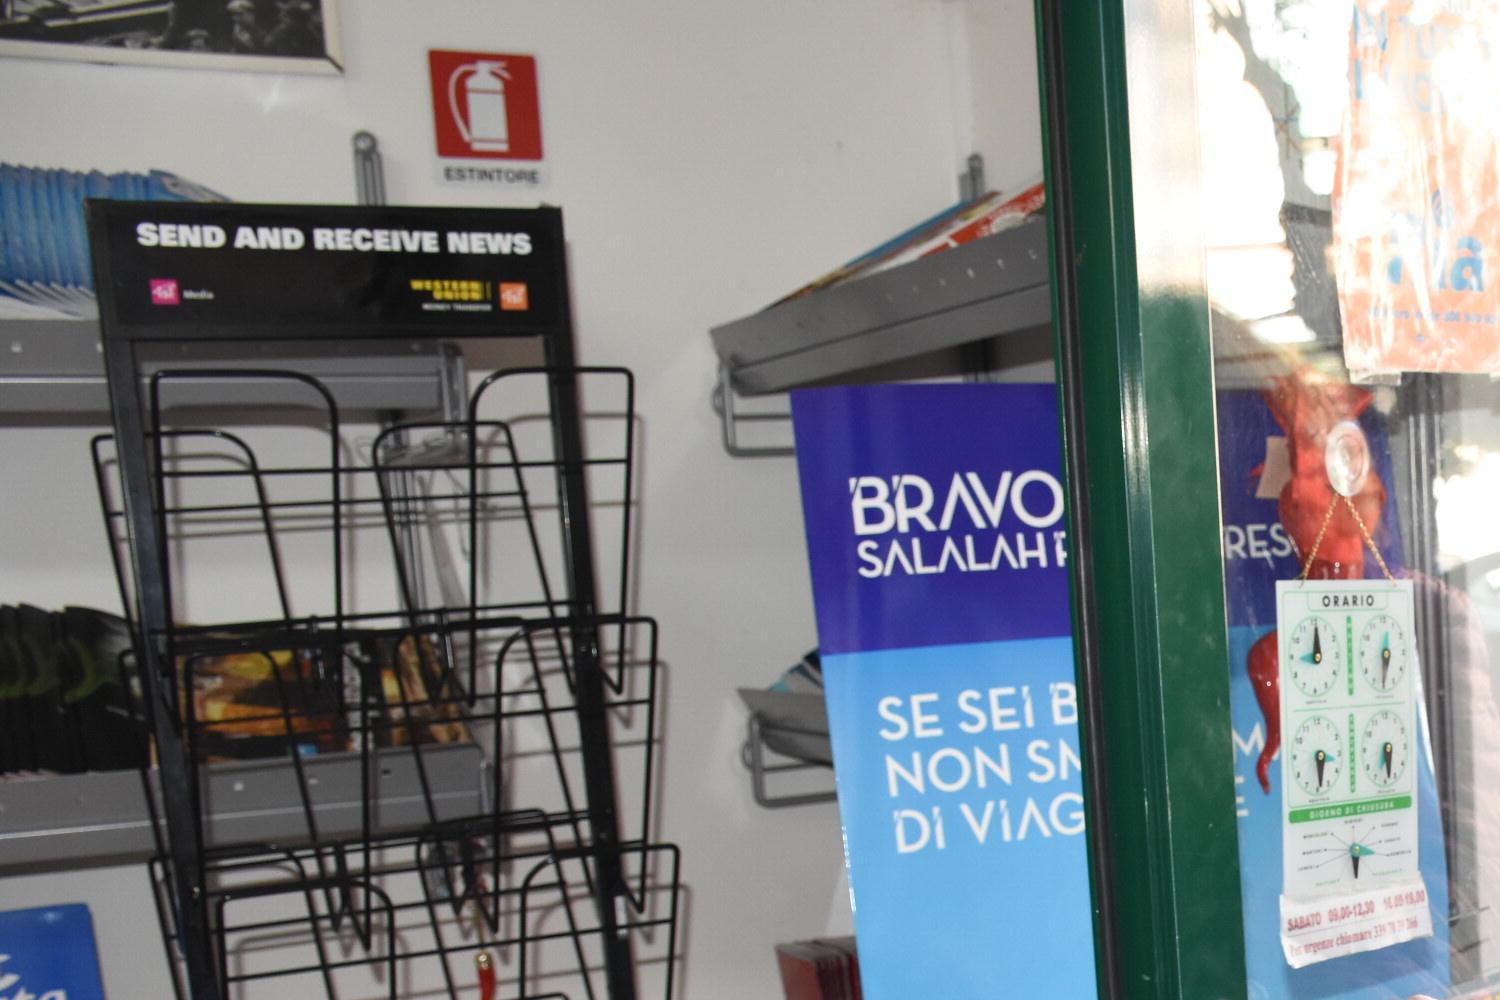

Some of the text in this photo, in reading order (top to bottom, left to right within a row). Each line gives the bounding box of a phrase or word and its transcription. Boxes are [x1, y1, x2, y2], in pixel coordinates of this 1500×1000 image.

[444, 167, 539, 184] ESTINTORE
[136, 222, 533, 255] SEND AND RECEIVE NEWS
[849, 470, 1065, 536] BRAVO
[857, 530, 1048, 579] SALALAH
[1322, 595, 1374, 607] ORARIO
[879, 693, 943, 741] SE
[958, 685, 1035, 734] SEI
[884, 744, 1013, 797] NON
[893, 792, 1086, 853] DI VIAG
[1309, 807, 1342, 819] GIORNO
[1356, 801, 1394, 813] CHIUSURA
[1288, 912, 1321, 931] SABATO
